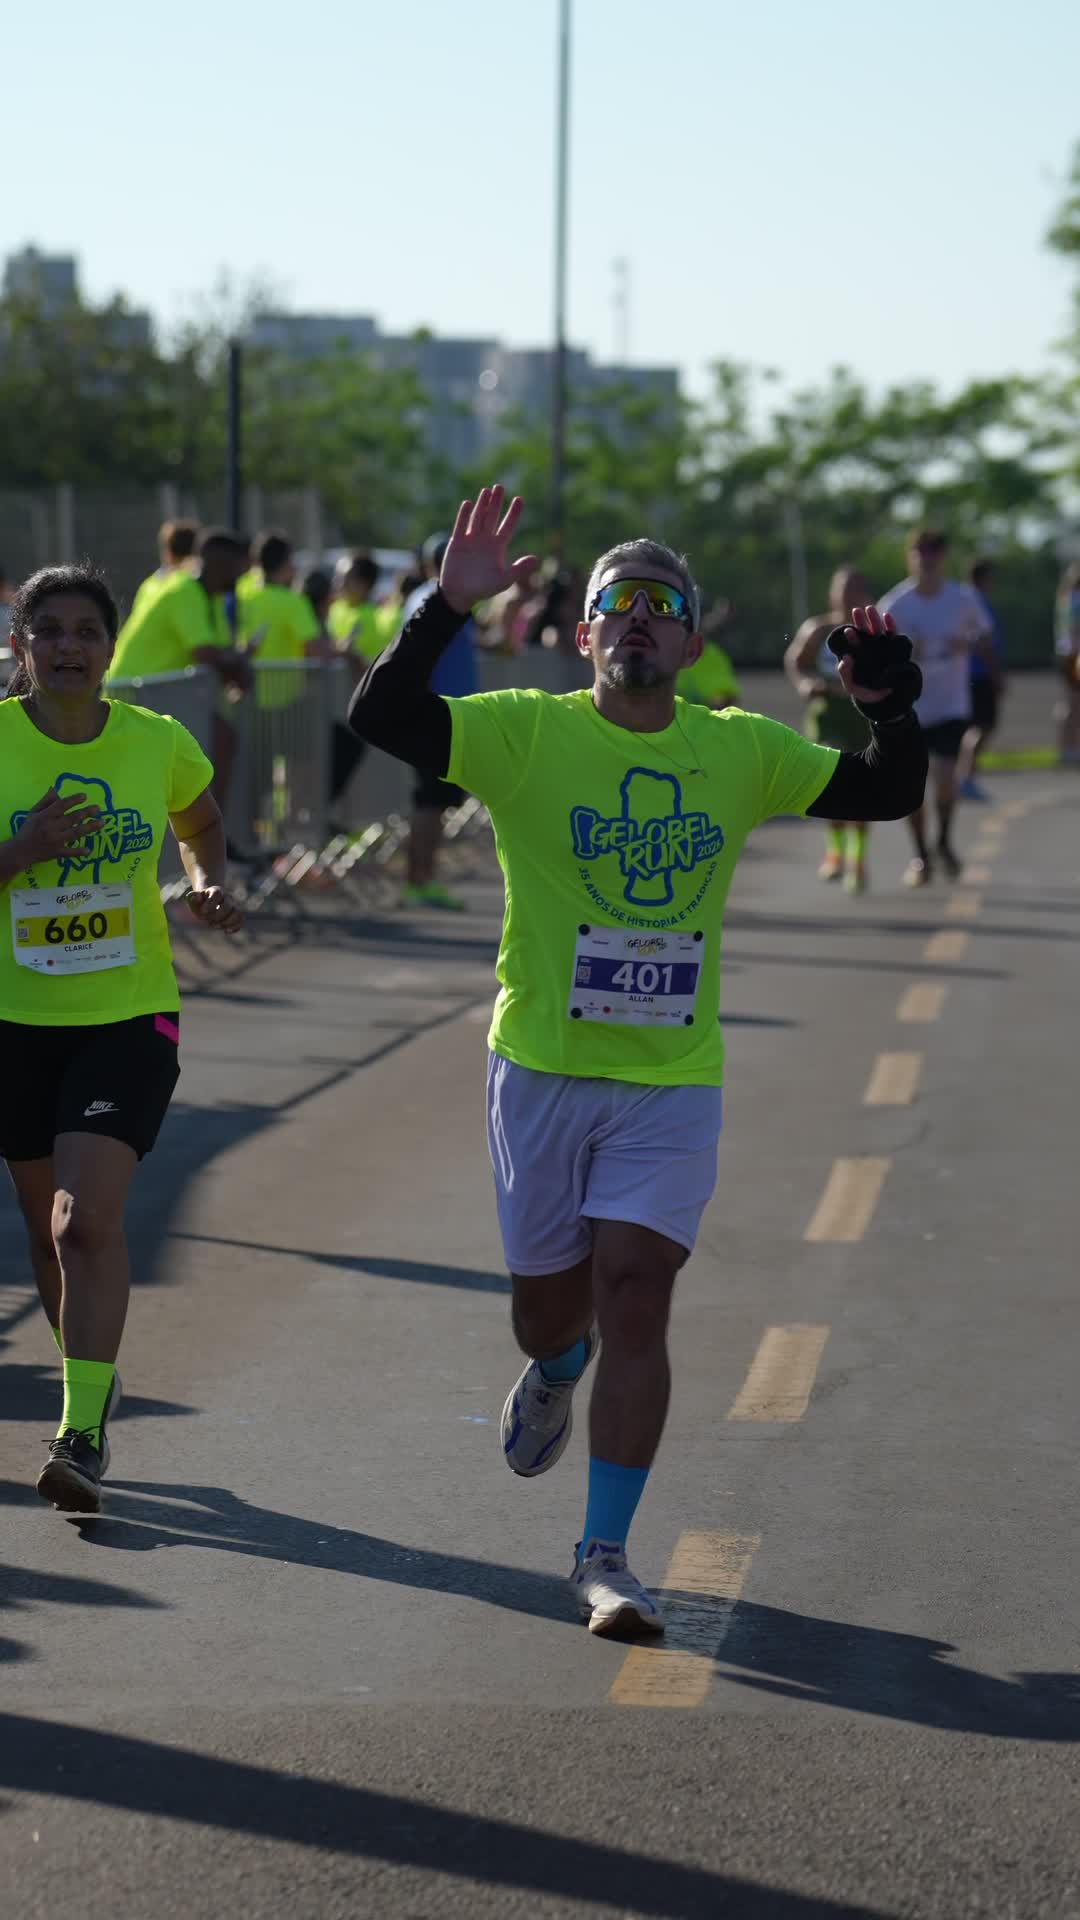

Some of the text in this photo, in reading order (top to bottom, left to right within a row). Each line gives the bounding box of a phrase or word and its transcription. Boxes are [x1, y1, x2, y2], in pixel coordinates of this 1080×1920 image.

[126, 837, 150, 850] 2026
[590, 816, 719, 848] GELOBEL
[622, 836, 694, 877] RUN
[584, 882, 611, 912] ANOS
[610, 908, 625, 921] DE
[678, 911, 688, 920] E
[45, 912, 108, 944] 660
[64, 943, 94, 952] CLARICE
[611, 962, 673, 994] 401
[628, 995, 654, 1003] ALLAN
[89, 1100, 115, 1110] NIKE
